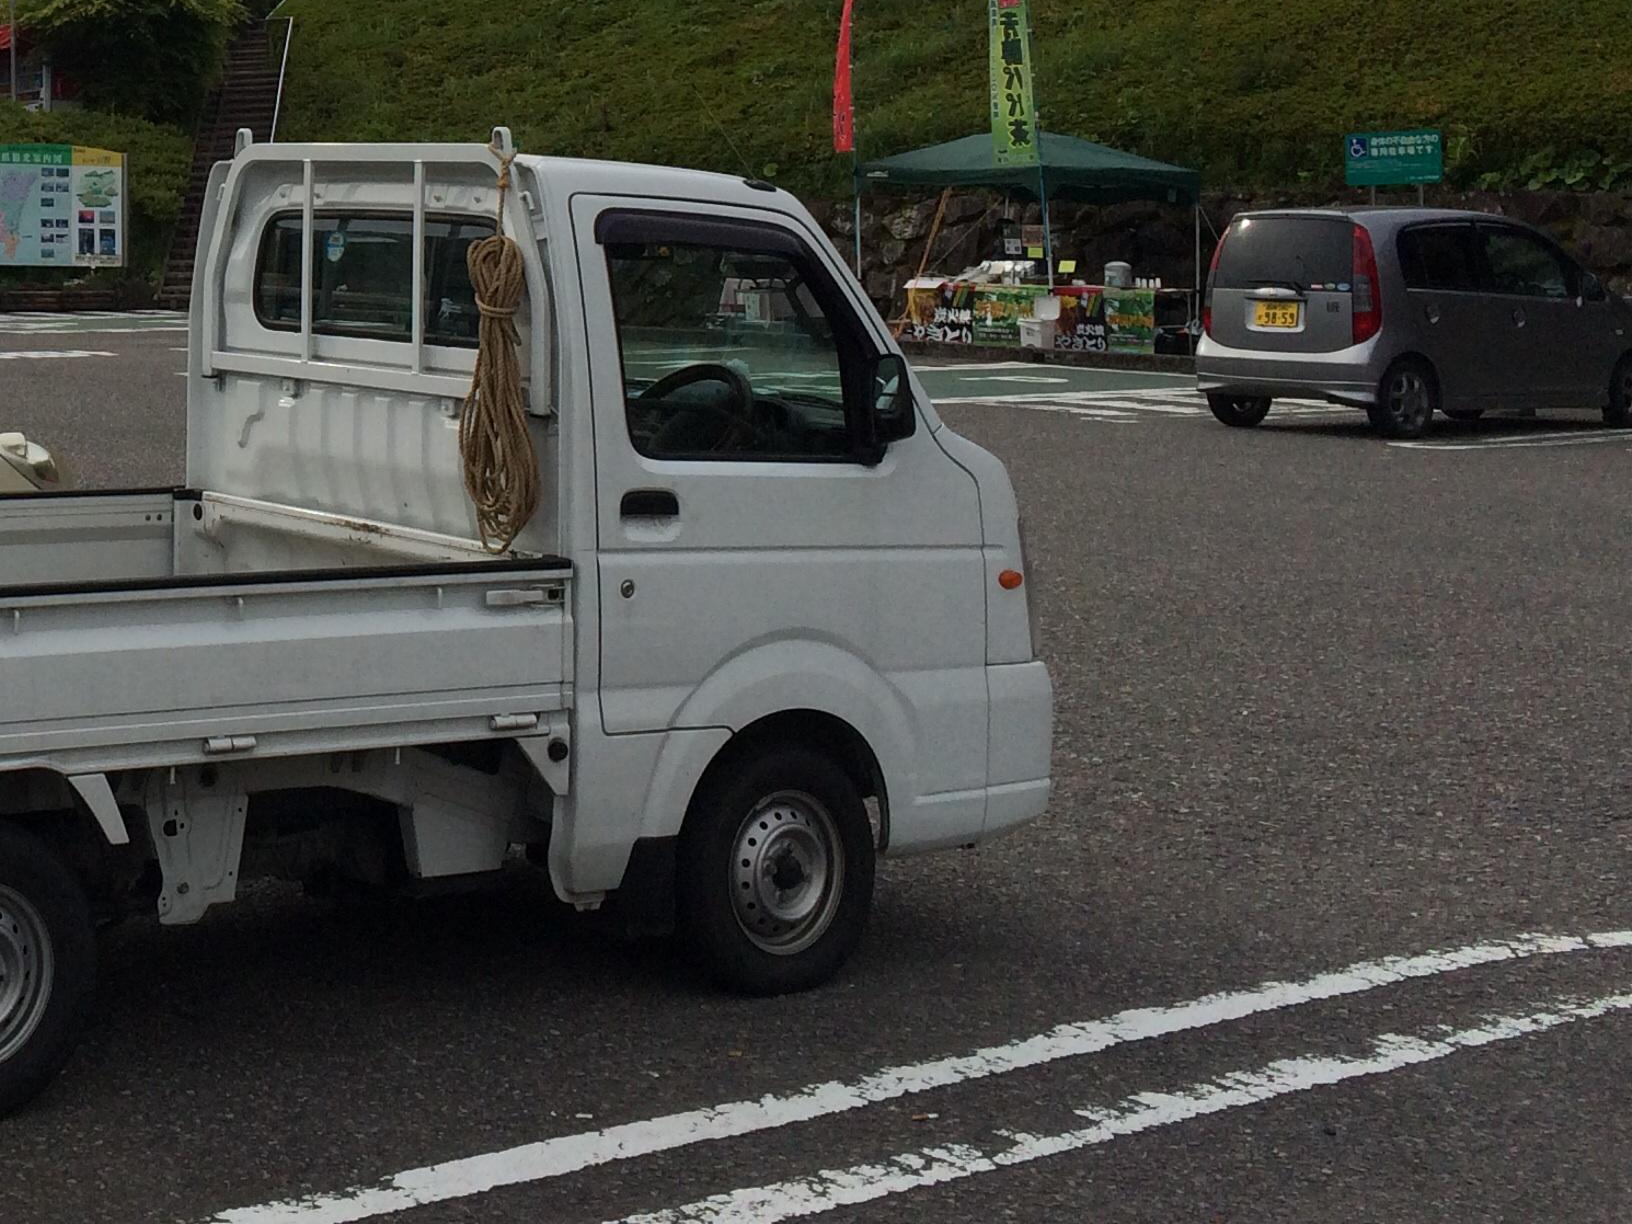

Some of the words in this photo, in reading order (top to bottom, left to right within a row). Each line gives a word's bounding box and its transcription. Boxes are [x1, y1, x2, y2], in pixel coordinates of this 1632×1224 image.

[934, 307, 973, 325] 炭火焼
[1076, 323, 1105, 337] 炭火焼
[1055, 334, 1107, 352] やきとり
